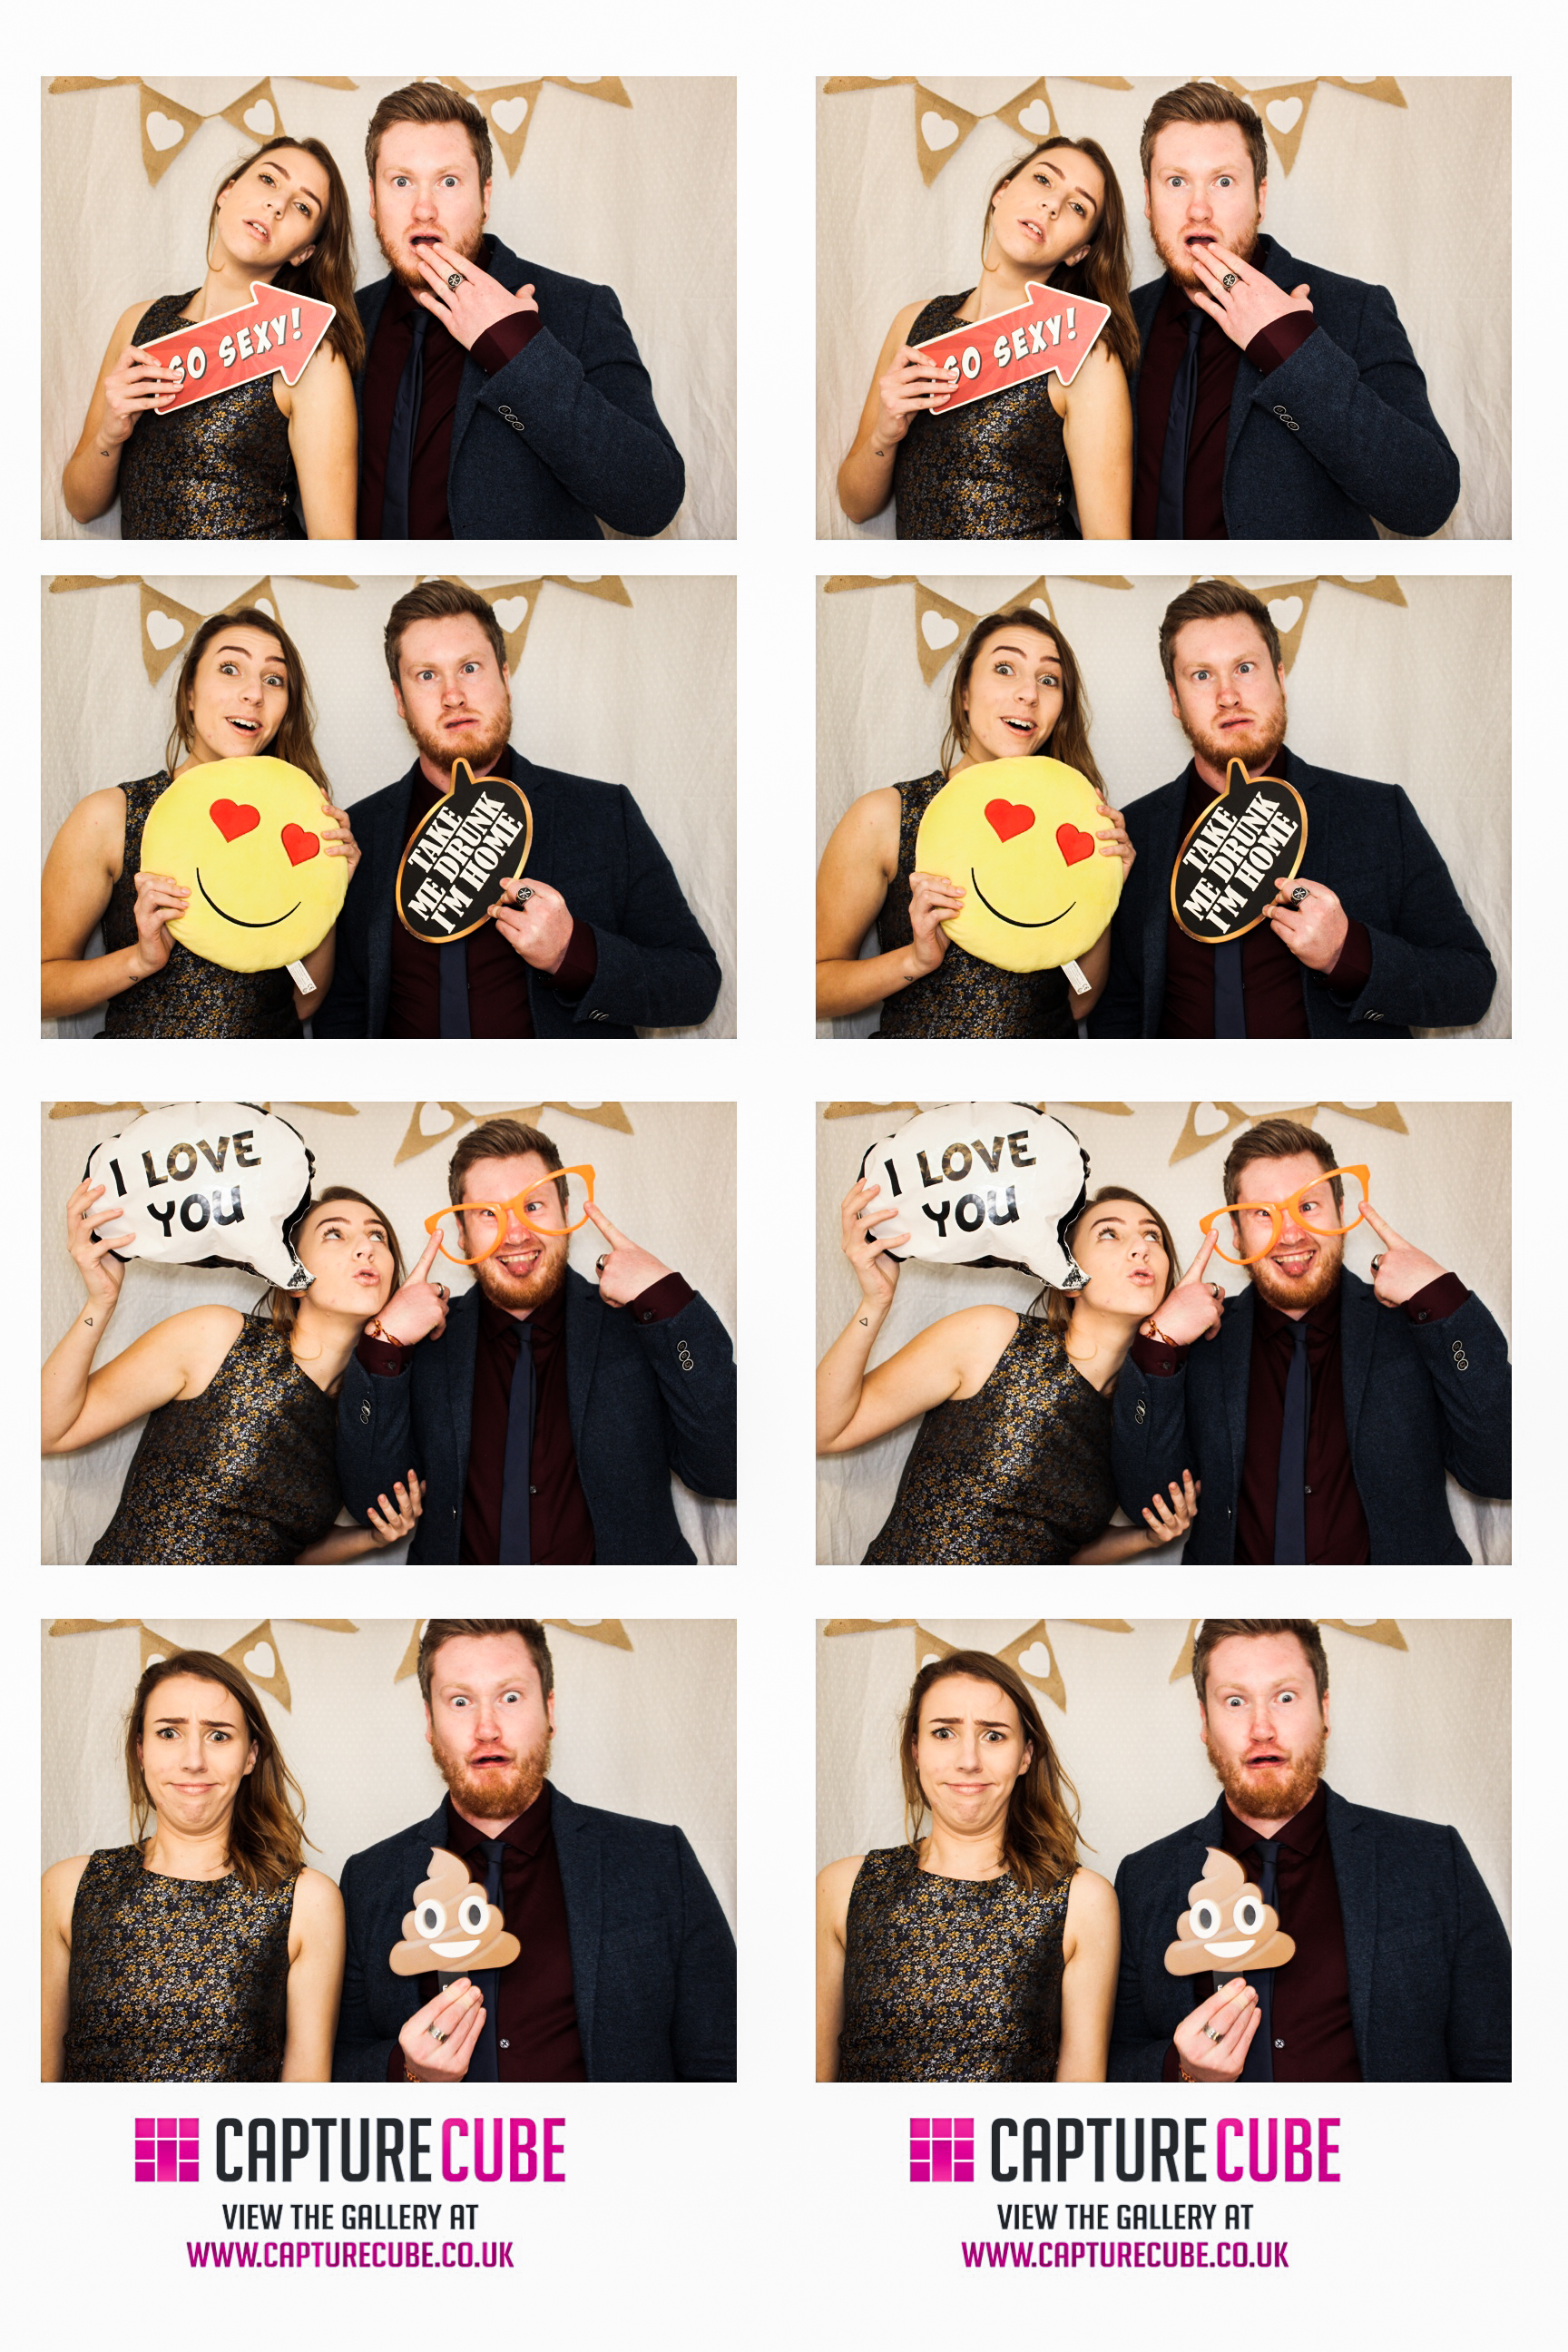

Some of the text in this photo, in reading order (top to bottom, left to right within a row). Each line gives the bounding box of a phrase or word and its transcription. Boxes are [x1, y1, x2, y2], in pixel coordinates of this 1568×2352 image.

[218, 307, 302, 368] SEXY!
[993, 307, 1077, 368] SEXY!
[407, 806, 463, 874] TAKE
[407, 791, 505, 922] ME DRUNK
[431, 811, 524, 935] I'M HOME
[1182, 806, 1238, 874] TAKE
[1182, 791, 1280, 922] ME DRUNK
[1206, 811, 1298, 935] I'M HOME
[109, 1130, 262, 1198] I LOVE
[884, 1130, 1037, 1198] I LOVE
[147, 1184, 246, 1238] YOU
[922, 1184, 1021, 1238] YOU
